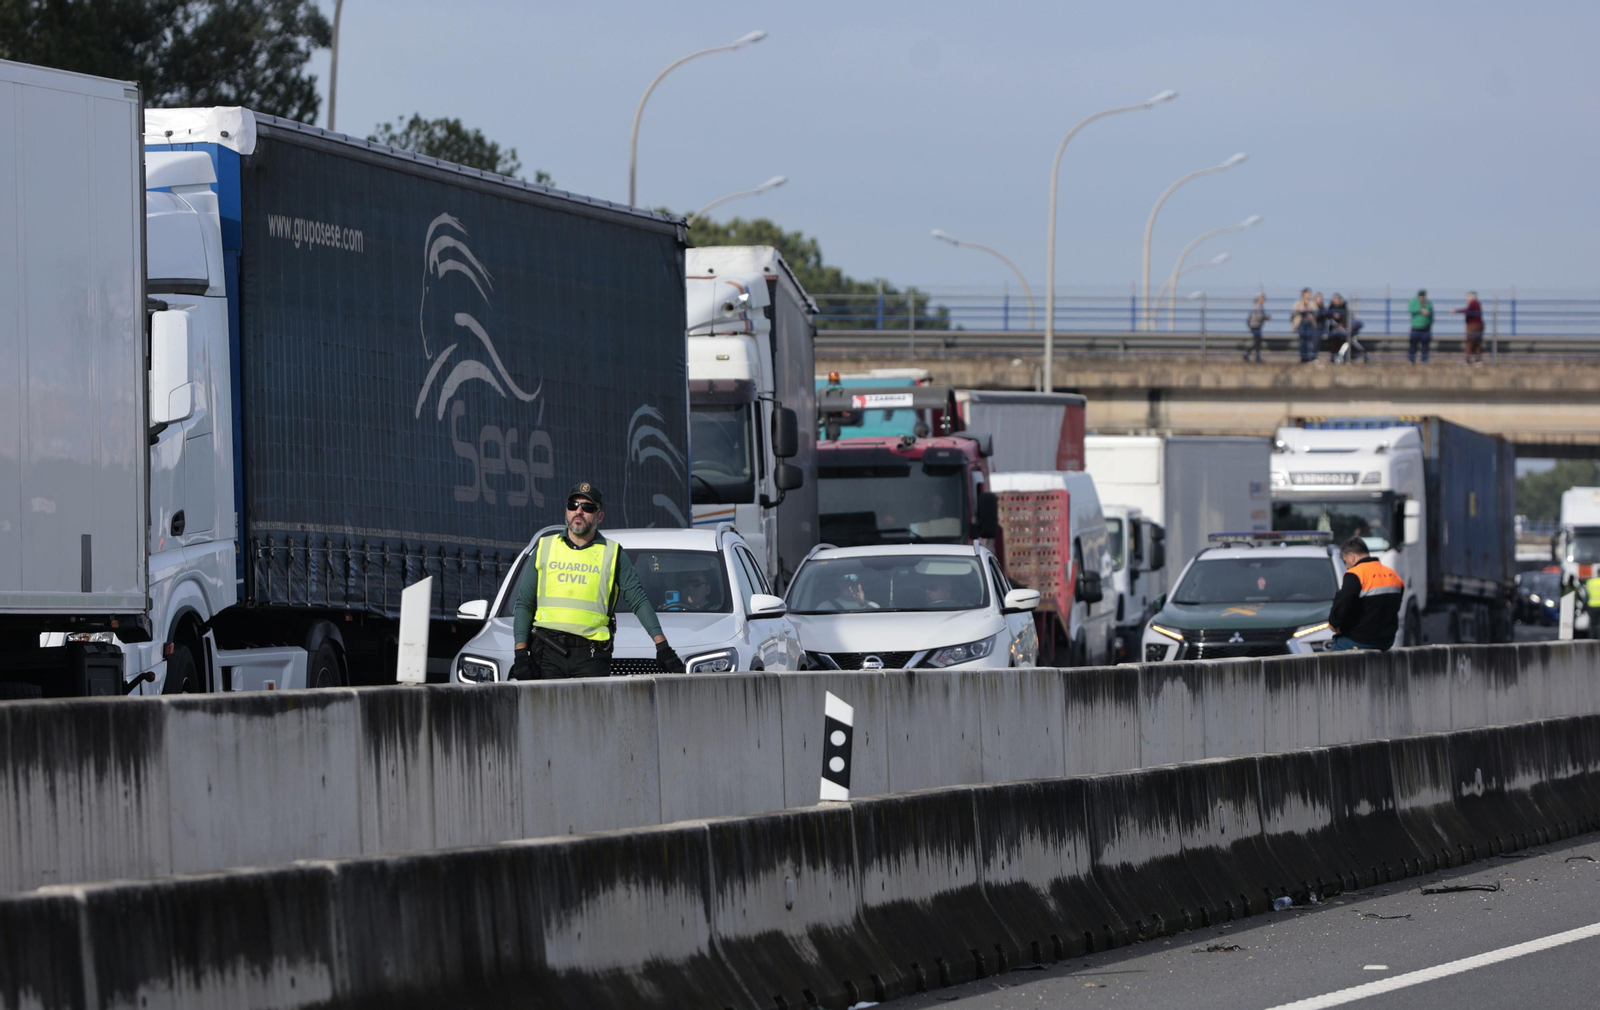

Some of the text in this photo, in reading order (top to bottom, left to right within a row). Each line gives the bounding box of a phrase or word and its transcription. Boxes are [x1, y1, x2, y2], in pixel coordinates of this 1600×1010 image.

[267, 213, 364, 253] www.gruposese.com
[451, 397, 554, 508] Sesé
[549, 561, 600, 574] GUARDIA
[557, 572, 588, 585] CIVIL
